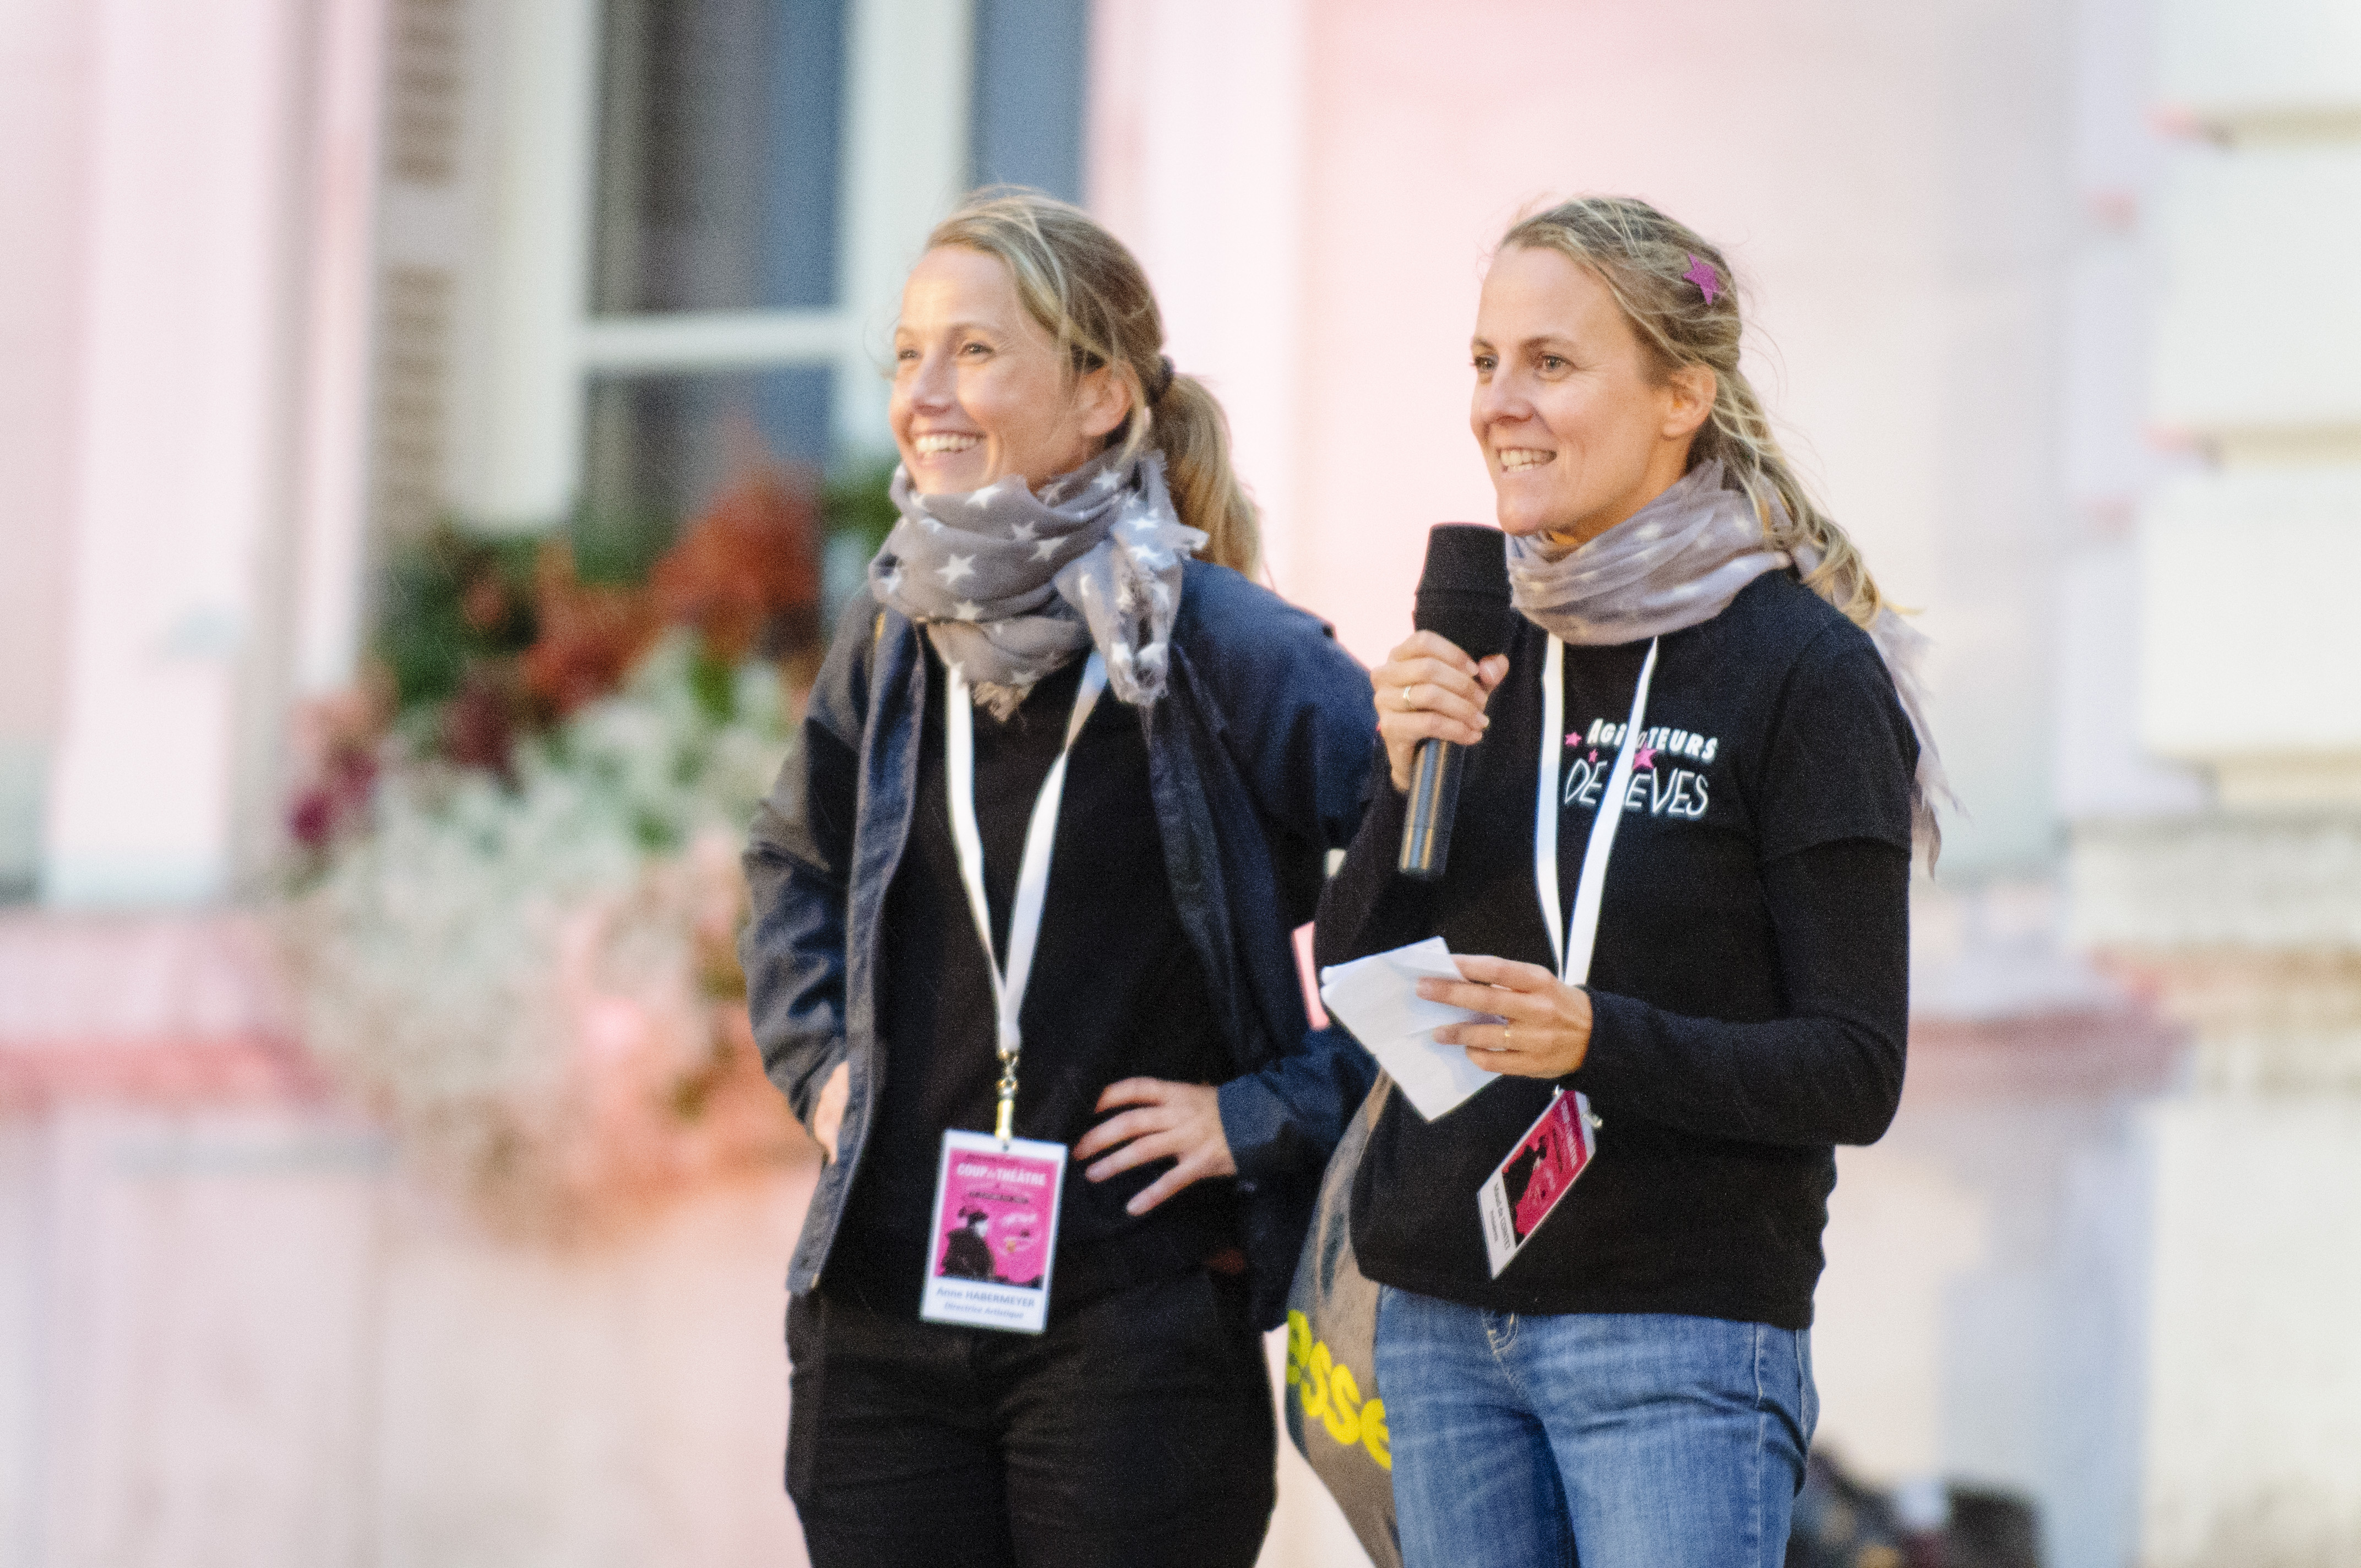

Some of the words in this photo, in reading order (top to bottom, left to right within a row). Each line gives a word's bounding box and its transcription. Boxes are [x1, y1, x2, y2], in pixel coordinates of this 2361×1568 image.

[1564, 758, 1608, 804] DE
[1624, 767, 1709, 816] EVES
[956, 1162, 989, 1178] COUP
[937, 1287, 963, 1299] Anne
[966, 1291, 1035, 1307] HABERMEYER
